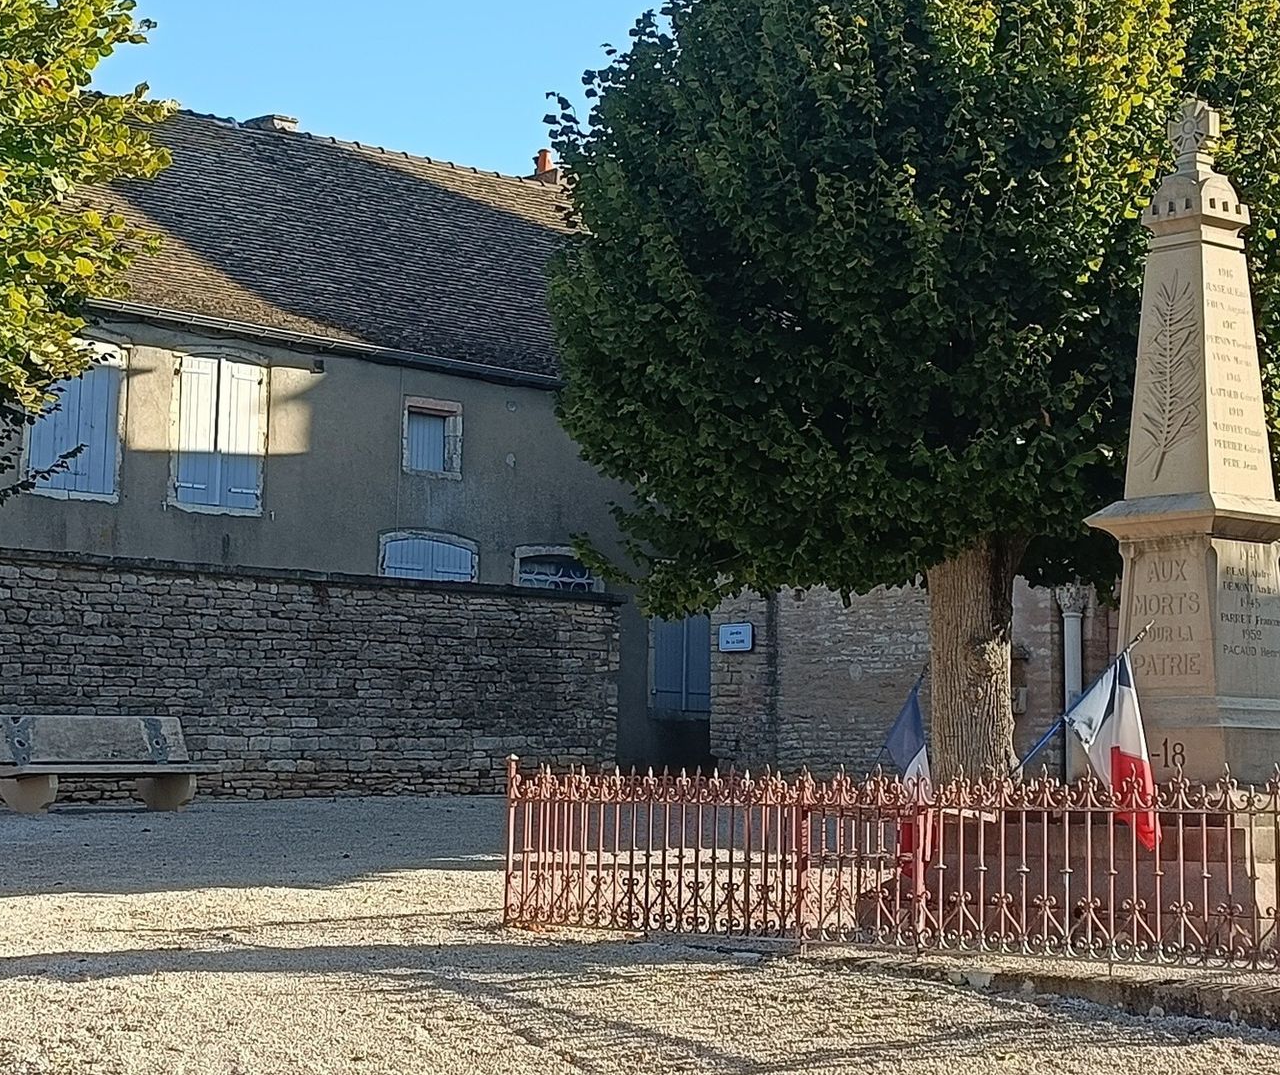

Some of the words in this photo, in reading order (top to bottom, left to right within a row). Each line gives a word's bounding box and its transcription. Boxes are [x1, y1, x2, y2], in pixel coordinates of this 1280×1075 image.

[1147, 559, 1187, 583] AUX
[1133, 592, 1200, 616] MORTS
[1141, 626, 1173, 642] OUR
[1177, 626, 1194, 642] LA
[1242, 629, 1263, 641] 1952
[1223, 644, 1257, 657] PACAUD
[1133, 652, 1201, 677] PATRIE
